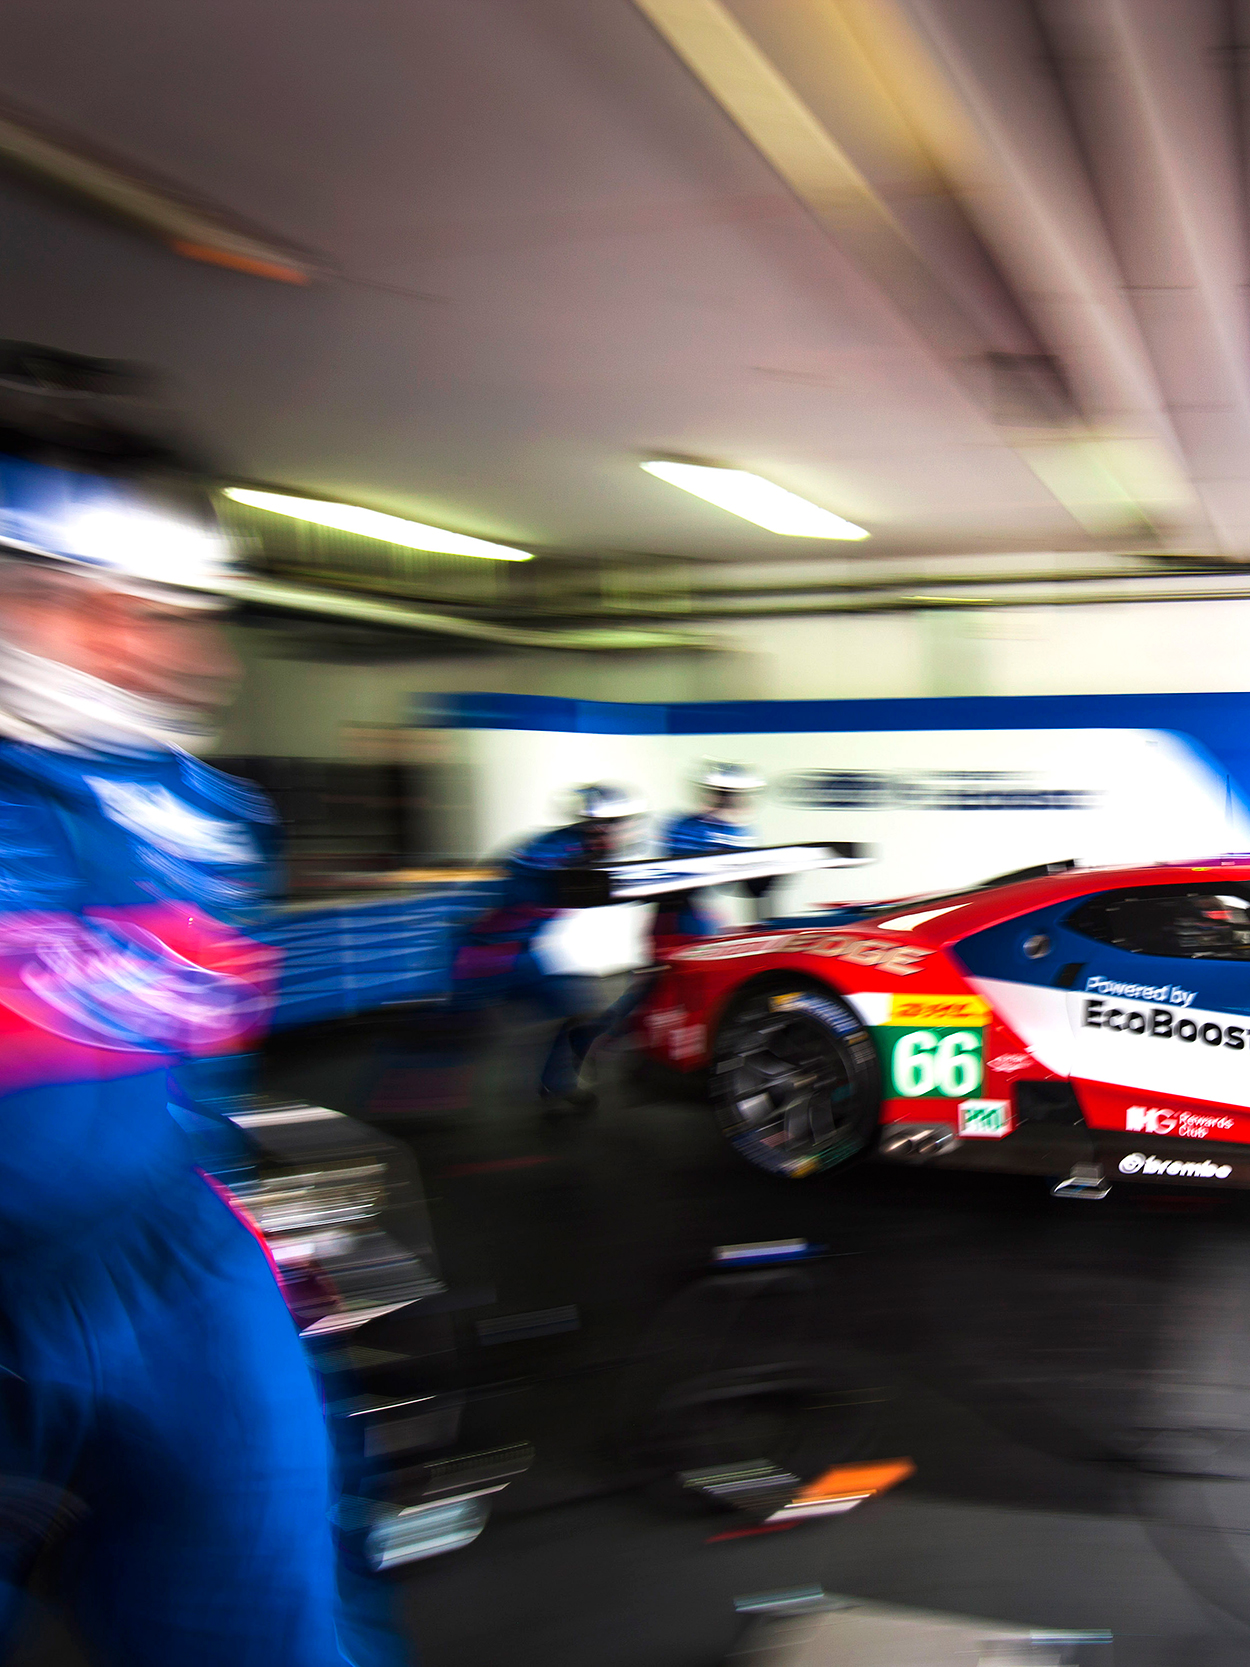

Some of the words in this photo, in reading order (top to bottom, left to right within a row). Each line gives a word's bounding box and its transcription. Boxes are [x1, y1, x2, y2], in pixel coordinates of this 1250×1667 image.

[778, 933, 938, 976] EDGE
[1087, 976, 1171, 1001] Powered
[1170, 985, 1198, 1007] by
[891, 1030, 983, 1097] 66
[1178, 1126, 1209, 1138] Club
[1179, 1111, 1235, 1129] Rewards
[1142, 1154, 1233, 1179] brembo
